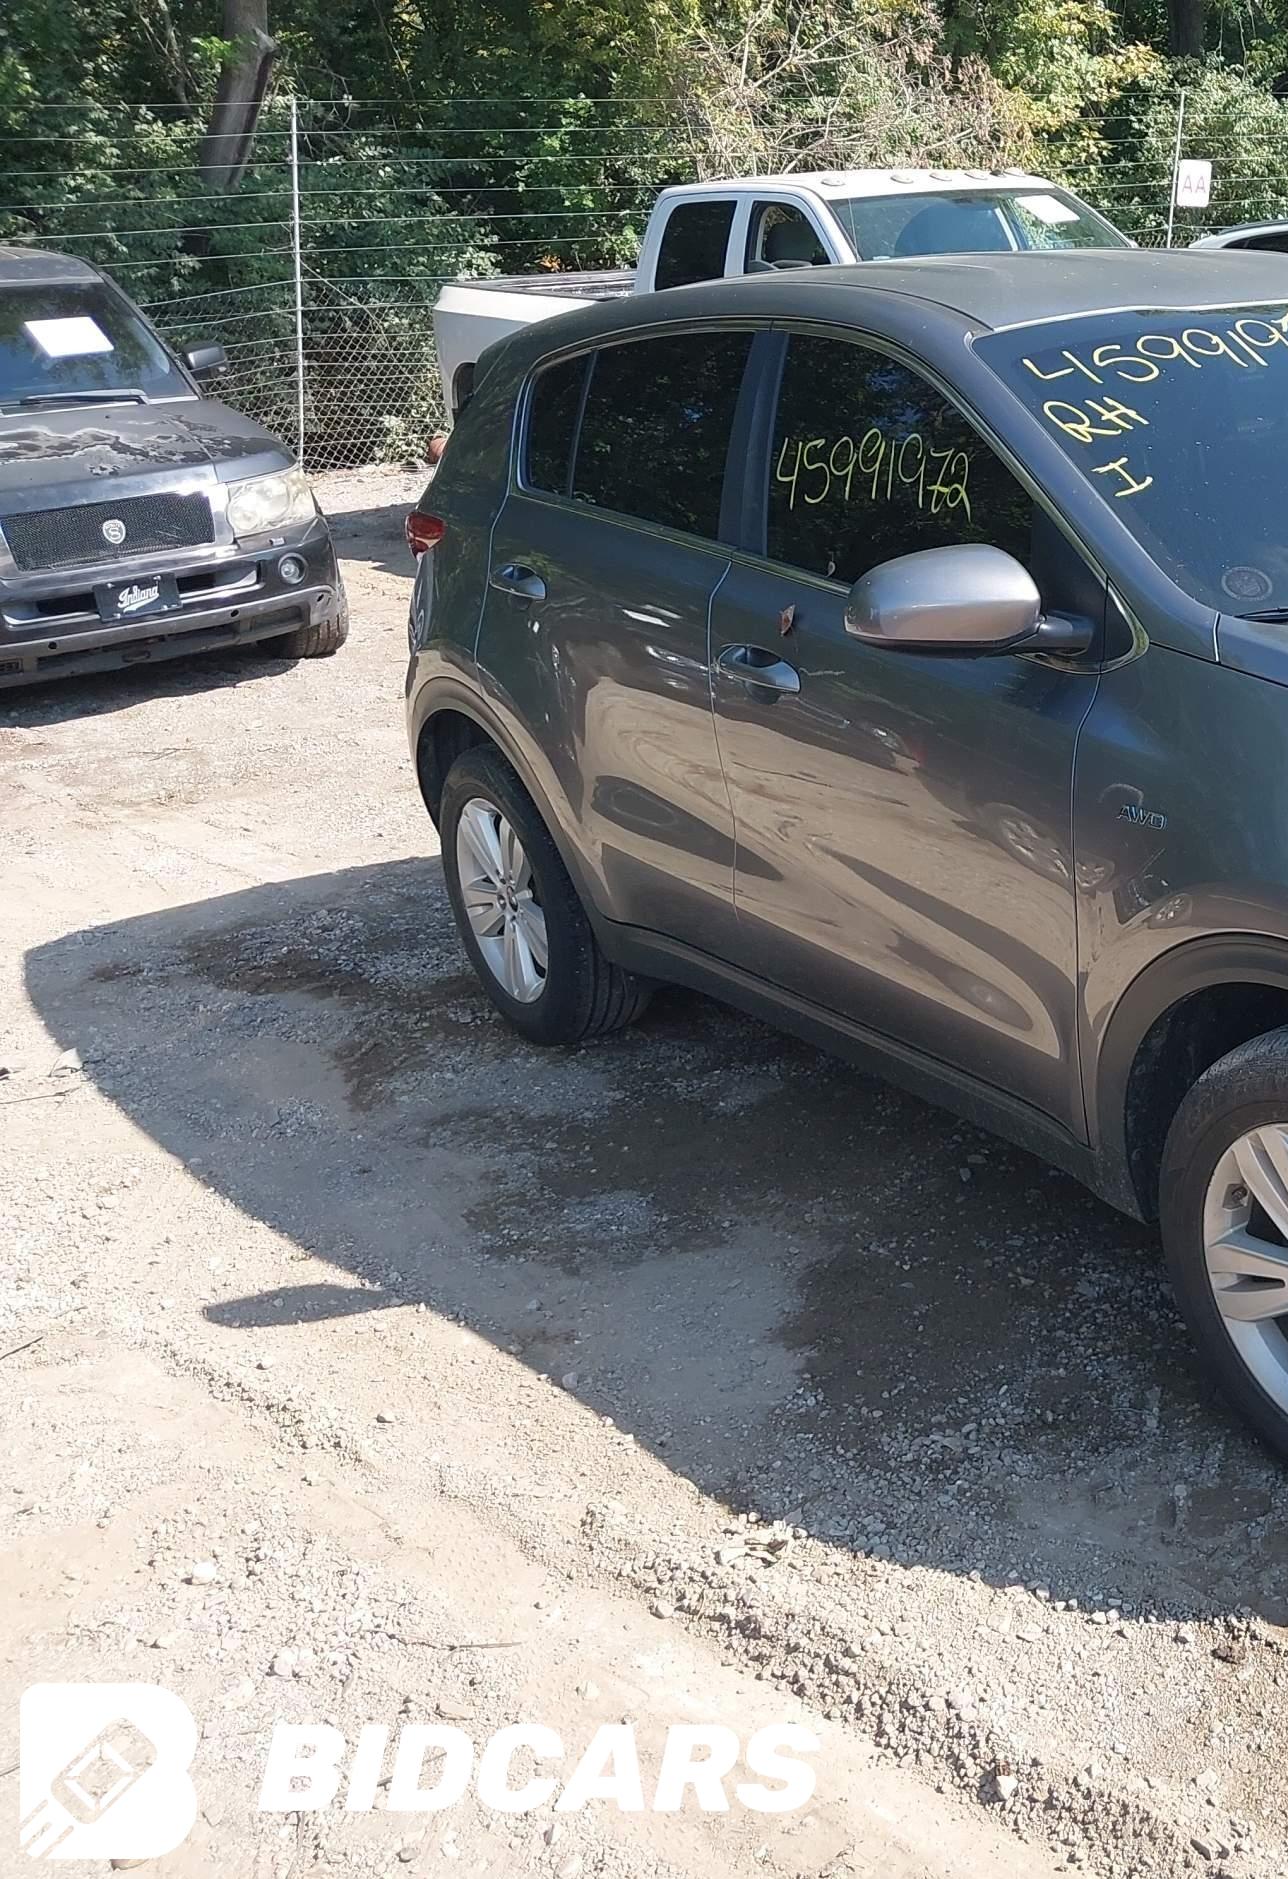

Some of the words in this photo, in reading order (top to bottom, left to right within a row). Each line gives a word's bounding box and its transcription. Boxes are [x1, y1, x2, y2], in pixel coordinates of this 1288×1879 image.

[1182, 174, 1207, 193] AA
[1043, 396, 1150, 443] RH
[117, 584, 160, 609] Indiana
[1116, 804, 1167, 830] AWD
